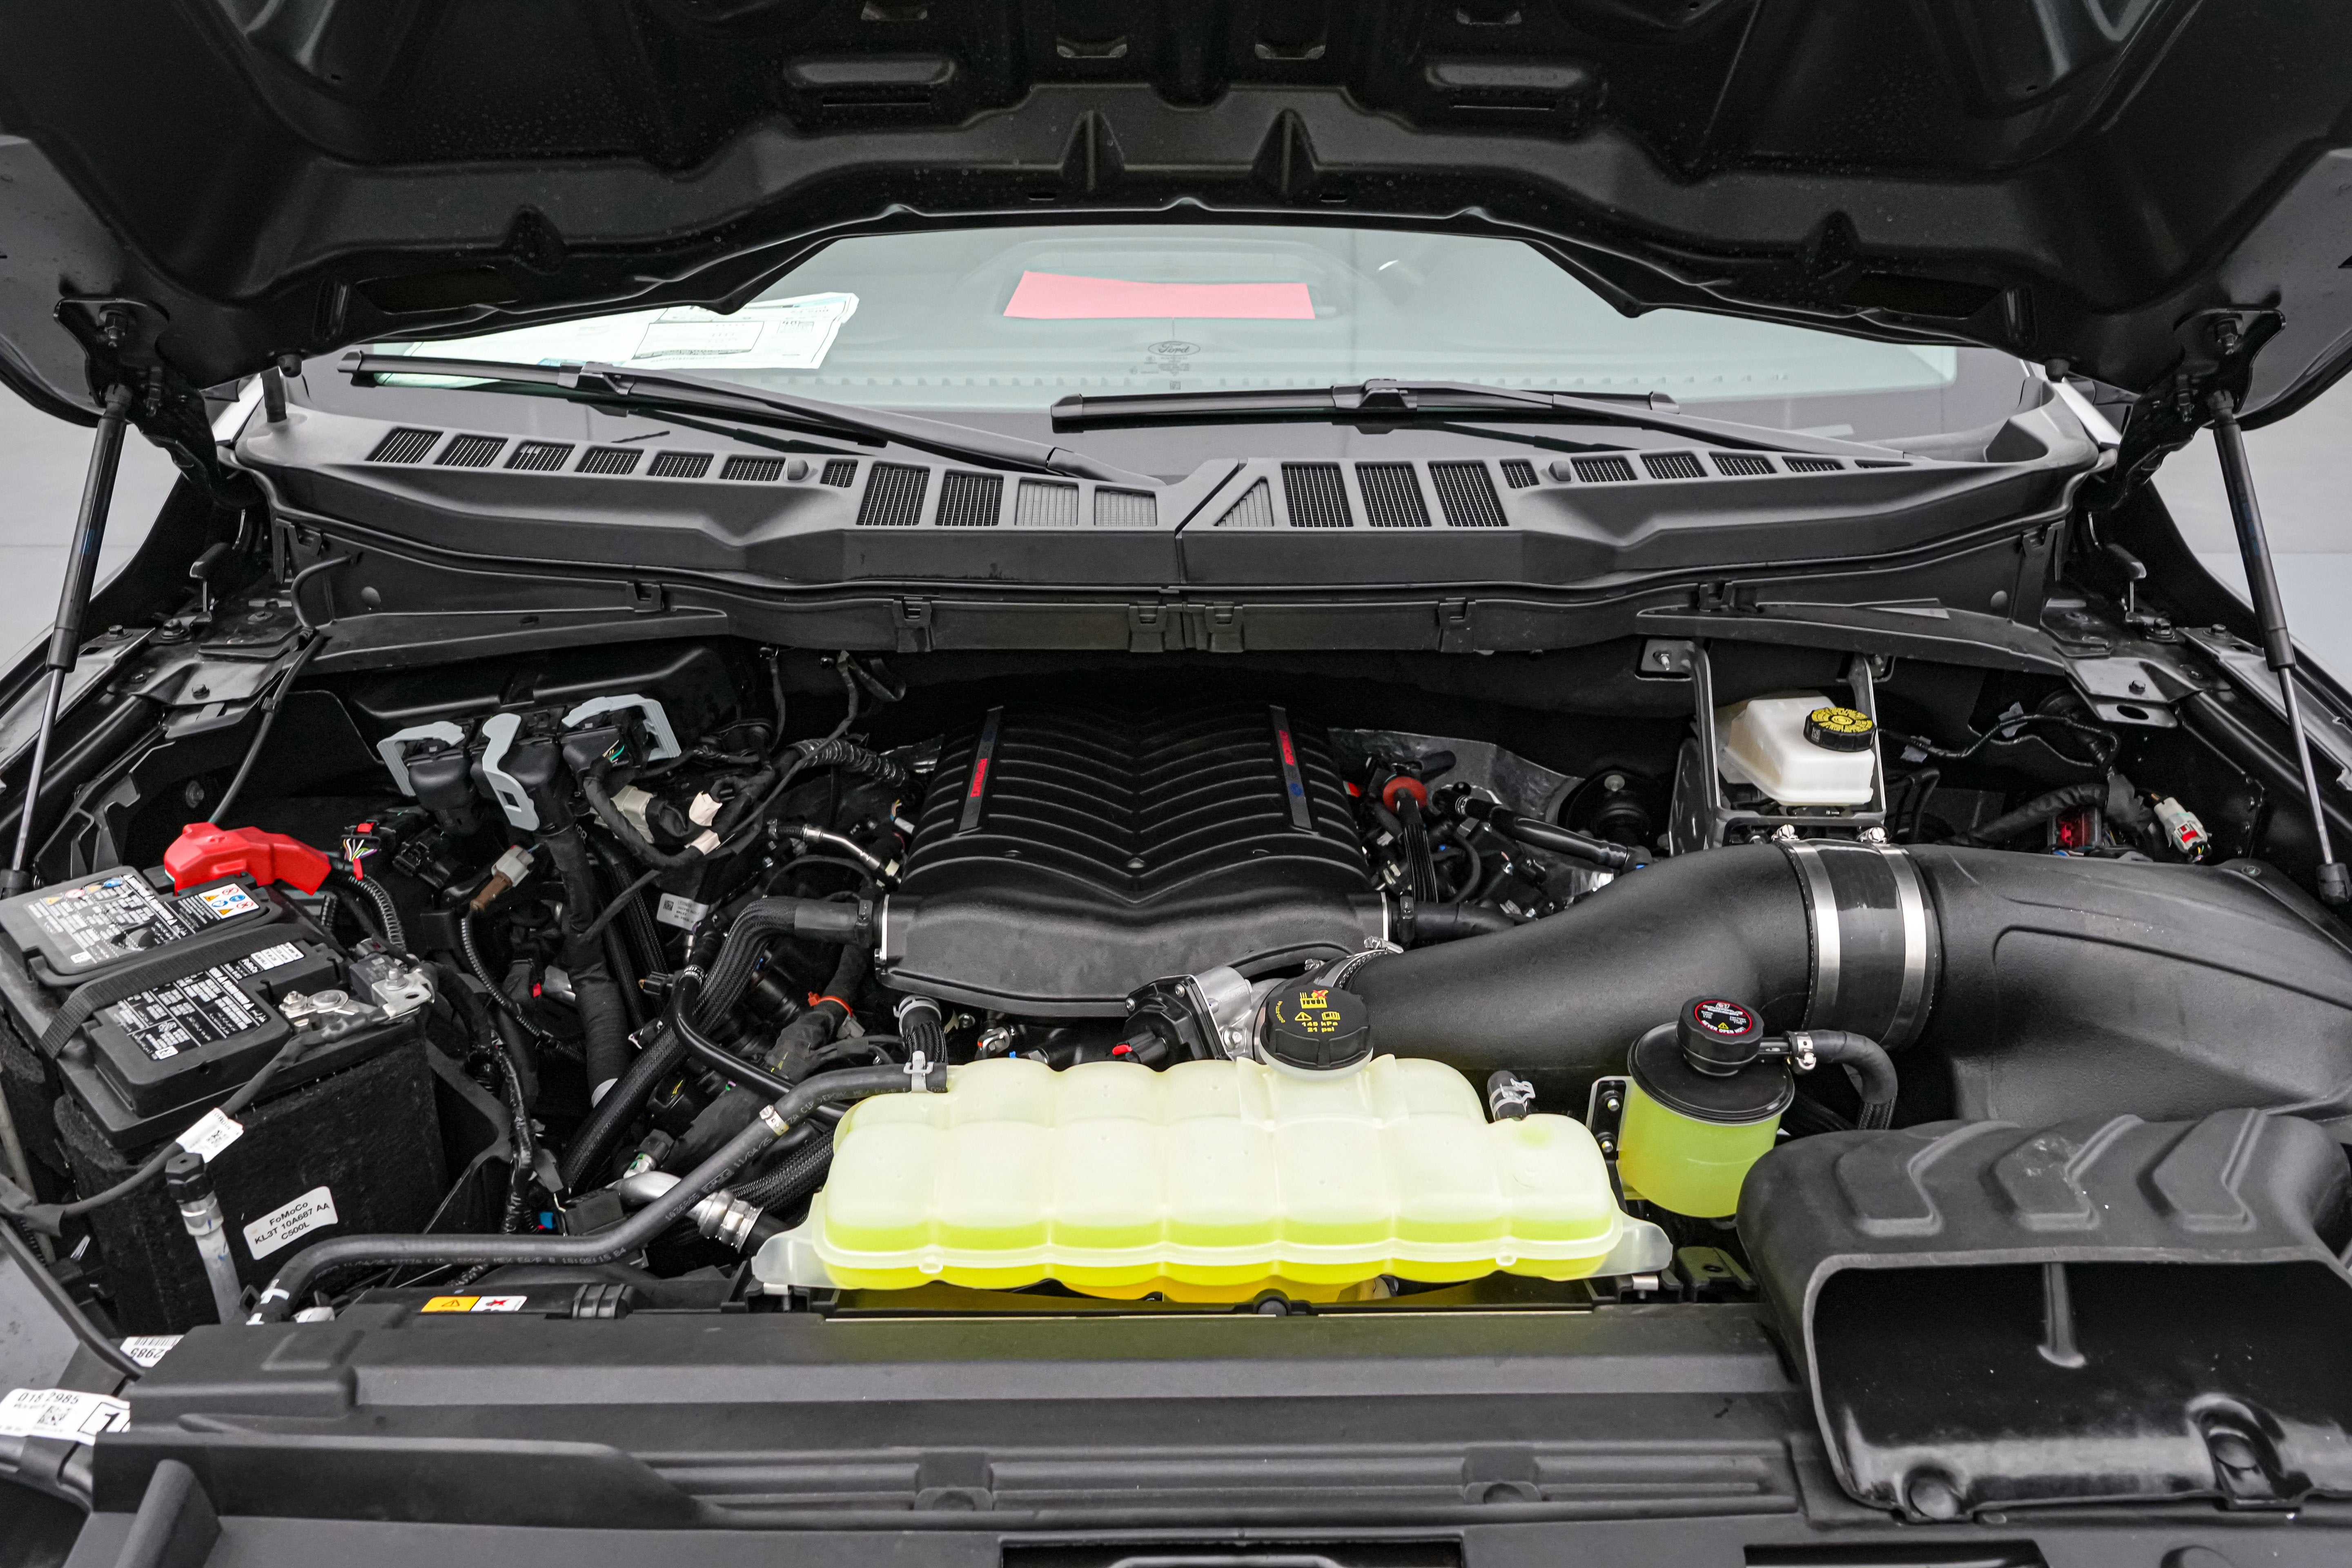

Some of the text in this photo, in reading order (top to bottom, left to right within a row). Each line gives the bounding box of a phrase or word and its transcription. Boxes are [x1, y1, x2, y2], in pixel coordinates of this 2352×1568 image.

[1158, 341, 1190, 353] Ford
[1702, 1020, 1718, 1031] NEVER
[269, 1202, 308, 1226] FoMoCo
[254, 1203, 330, 1245] KL3T 10A687 AA
[281, 1222, 310, 1240] C500L
[131, 1348, 165, 1359] 2985
[46, 1392, 80, 1405] 2985
